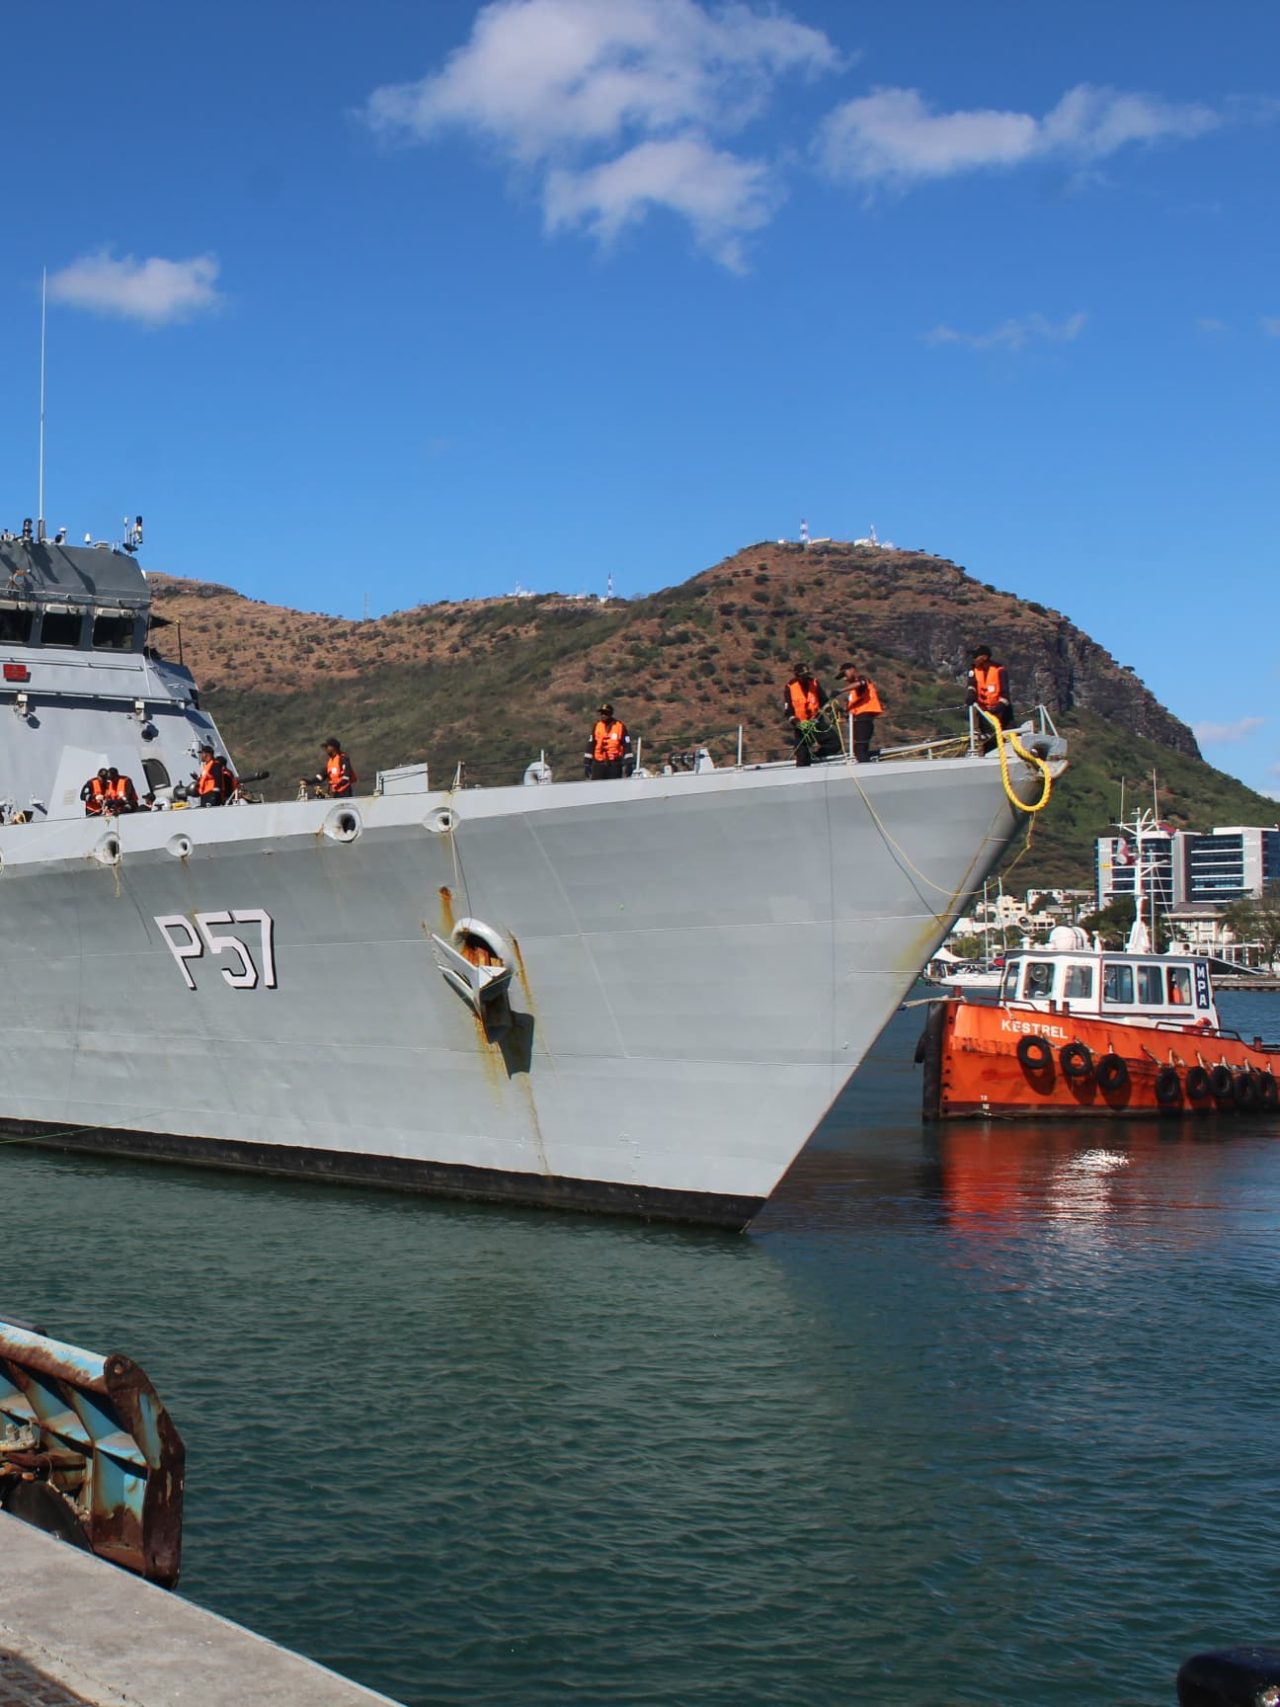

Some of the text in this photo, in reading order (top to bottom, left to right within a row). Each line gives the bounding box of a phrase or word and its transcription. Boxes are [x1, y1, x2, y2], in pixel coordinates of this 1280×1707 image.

[154, 909, 277, 990] P57
[1196, 965, 1208, 1006] MPA
[1001, 1019, 1068, 1040] KESTREL
